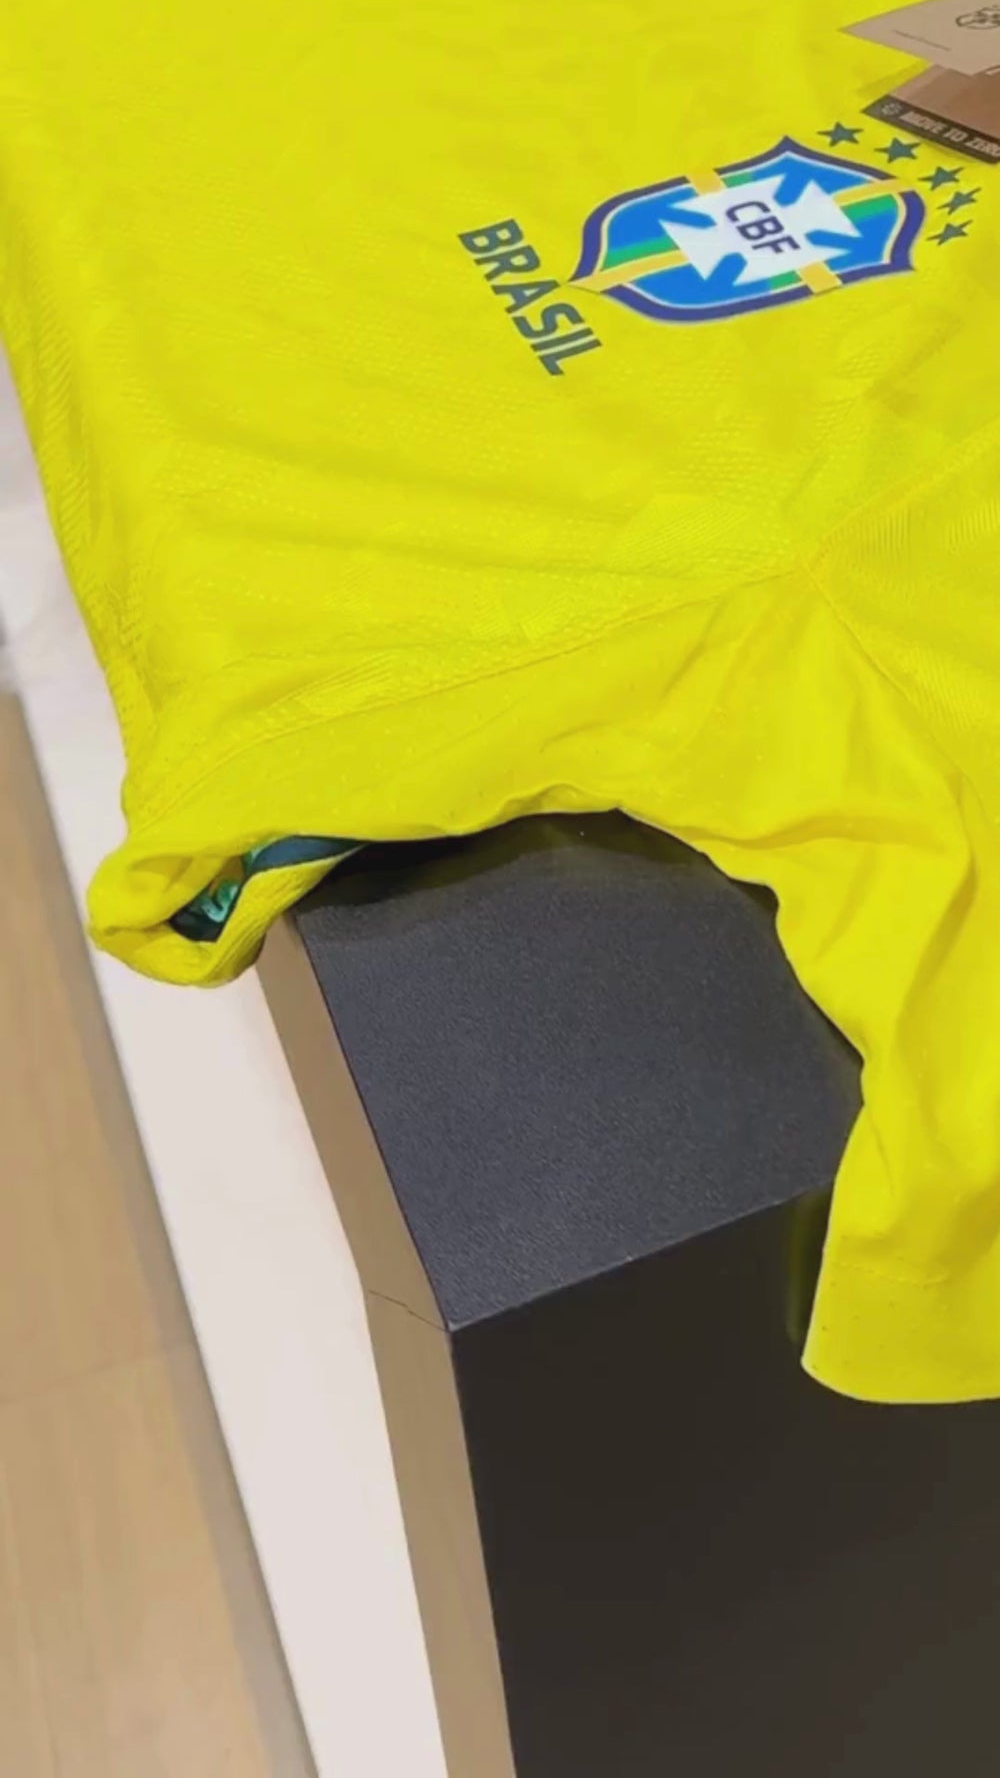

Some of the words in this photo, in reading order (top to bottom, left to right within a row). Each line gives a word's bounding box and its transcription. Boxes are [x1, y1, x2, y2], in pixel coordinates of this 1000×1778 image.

[899, 110, 947, 134] MOVE
[942, 128, 968, 143] TO
[725, 200, 801, 255] CBF
[457, 218, 603, 377] BRASIL
